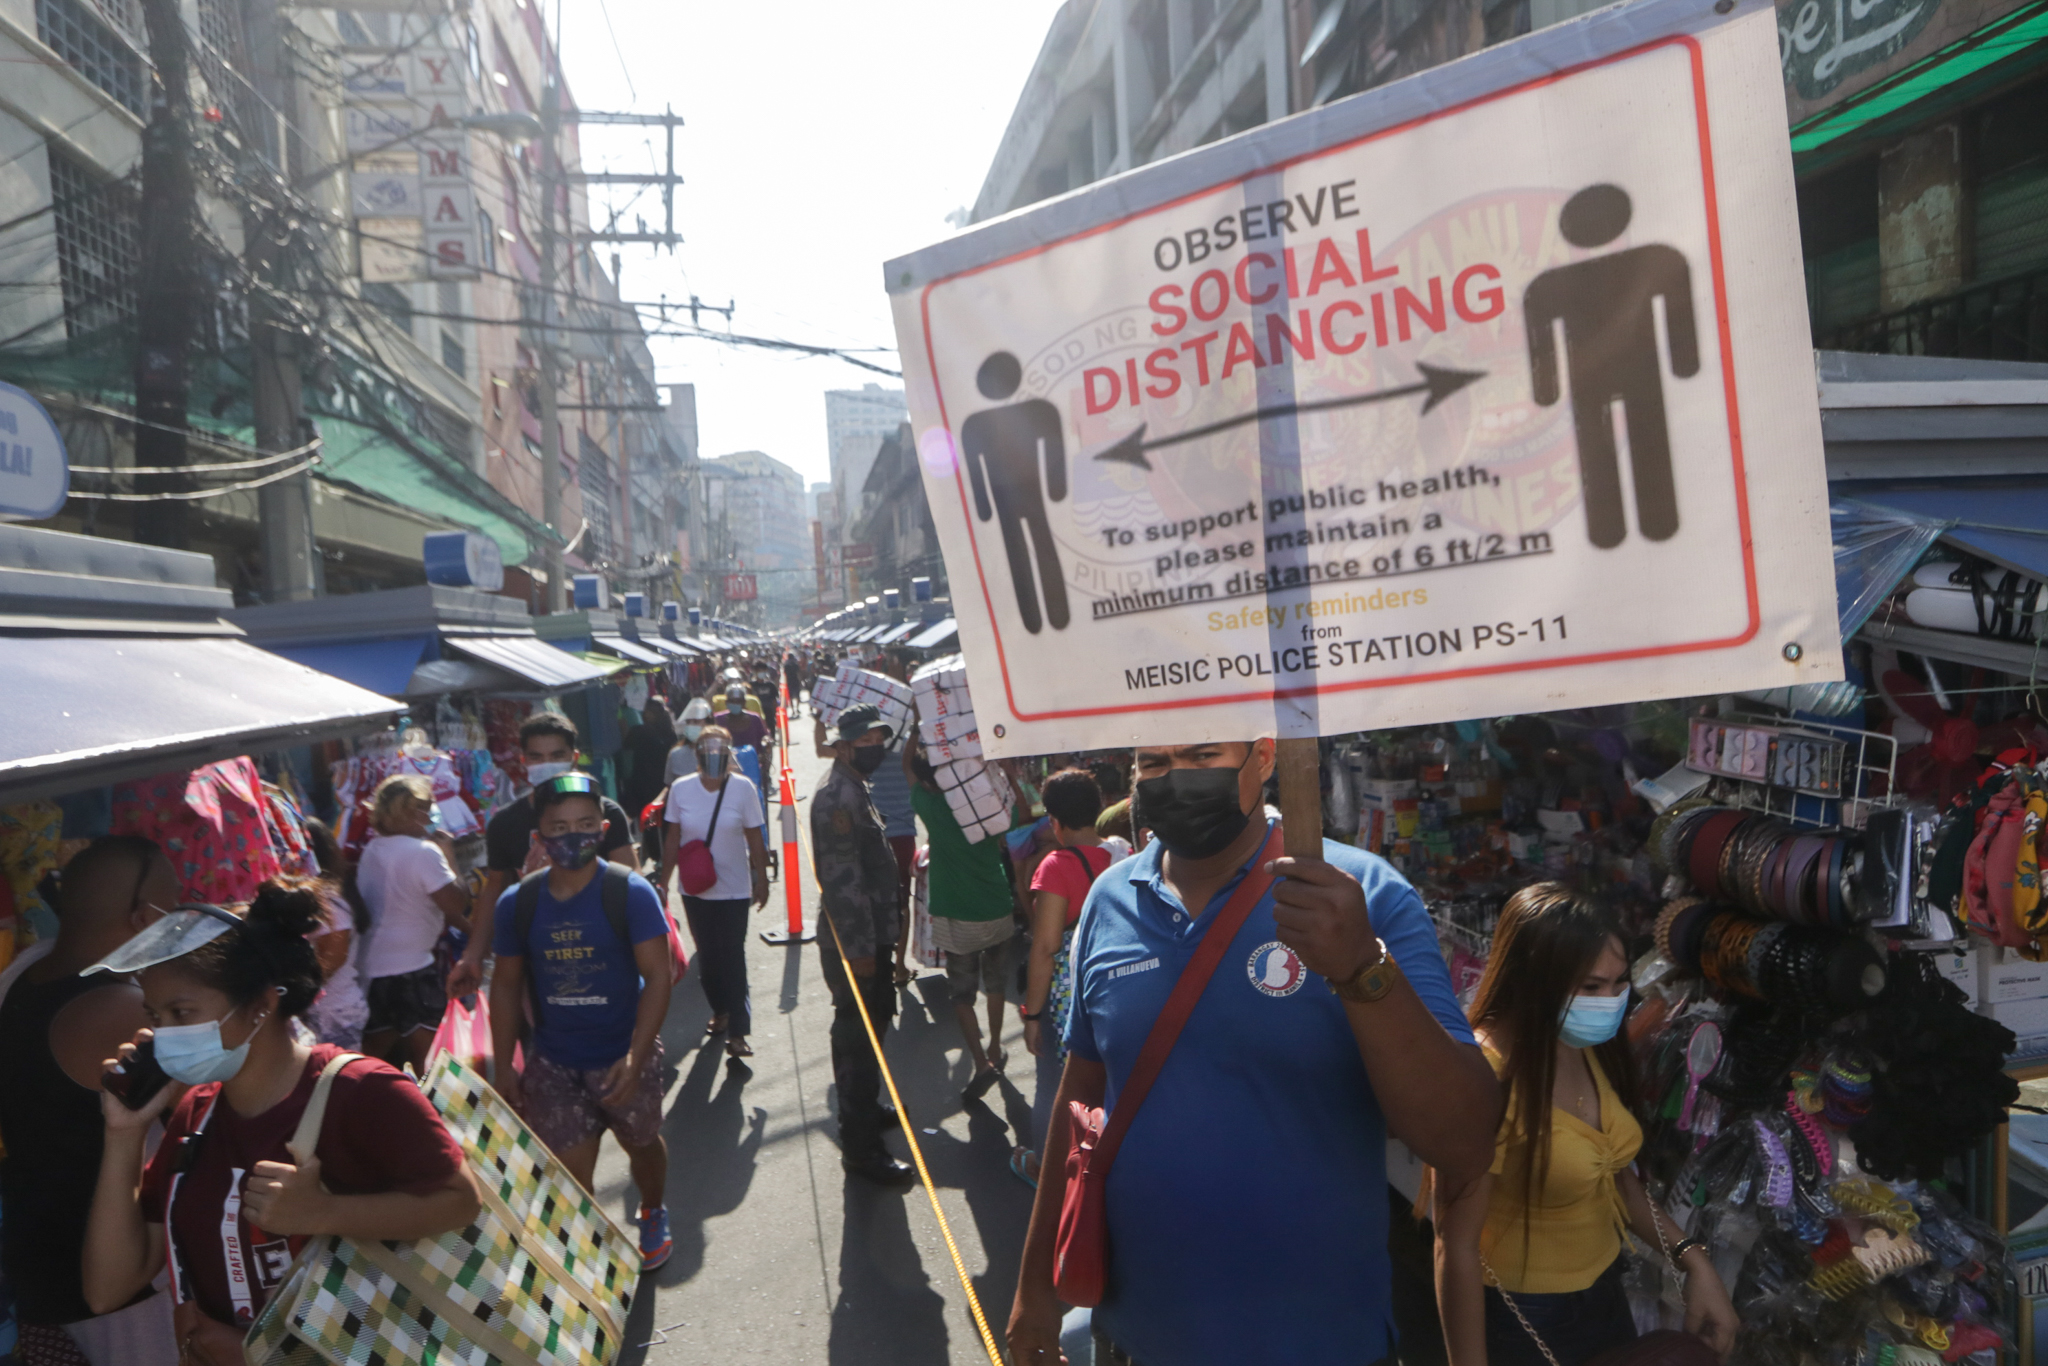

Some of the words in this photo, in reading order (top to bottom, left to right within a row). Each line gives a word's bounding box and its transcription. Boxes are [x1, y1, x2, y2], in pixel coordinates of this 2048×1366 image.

[420, 57, 466, 267] YAMAS
[1154, 179, 1360, 271] OBSERVE
[1149, 227, 1399, 336] SOCIAL
[1083, 263, 1505, 415] DISTANCING
[1102, 527, 1134, 548] To
[1146, 500, 1258, 541] support
[1268, 485, 1366, 521] public
[1377, 465, 1501, 502] health,
[1156, 540, 1254, 577] please
[1265, 514, 1409, 552] maintain
[1423, 511, 1443, 531] a
[1092, 583, 1214, 617] minimum
[1225, 558, 1360, 595] distance
[1372, 548, 1402, 573] of
[1415, 545, 1434, 567] 6
[1447, 533, 1505, 562] ft/2
[1519, 530, 1551, 552] m
[1207, 605, 1287, 631] Safety
[1295, 587, 1429, 619] reminders
[1124, 658, 1210, 690] MEISIC
[1217, 645, 1321, 679] POLICE
[1328, 628, 1463, 667] STATION
[1472, 614, 1568, 650] PS-11
[1301, 624, 1342, 641] from
[544, 947, 595, 960] FIRST
[1116, 957, 1160, 978] VILLANUEVA
[226, 1236, 245, 1283] CRAFTED
